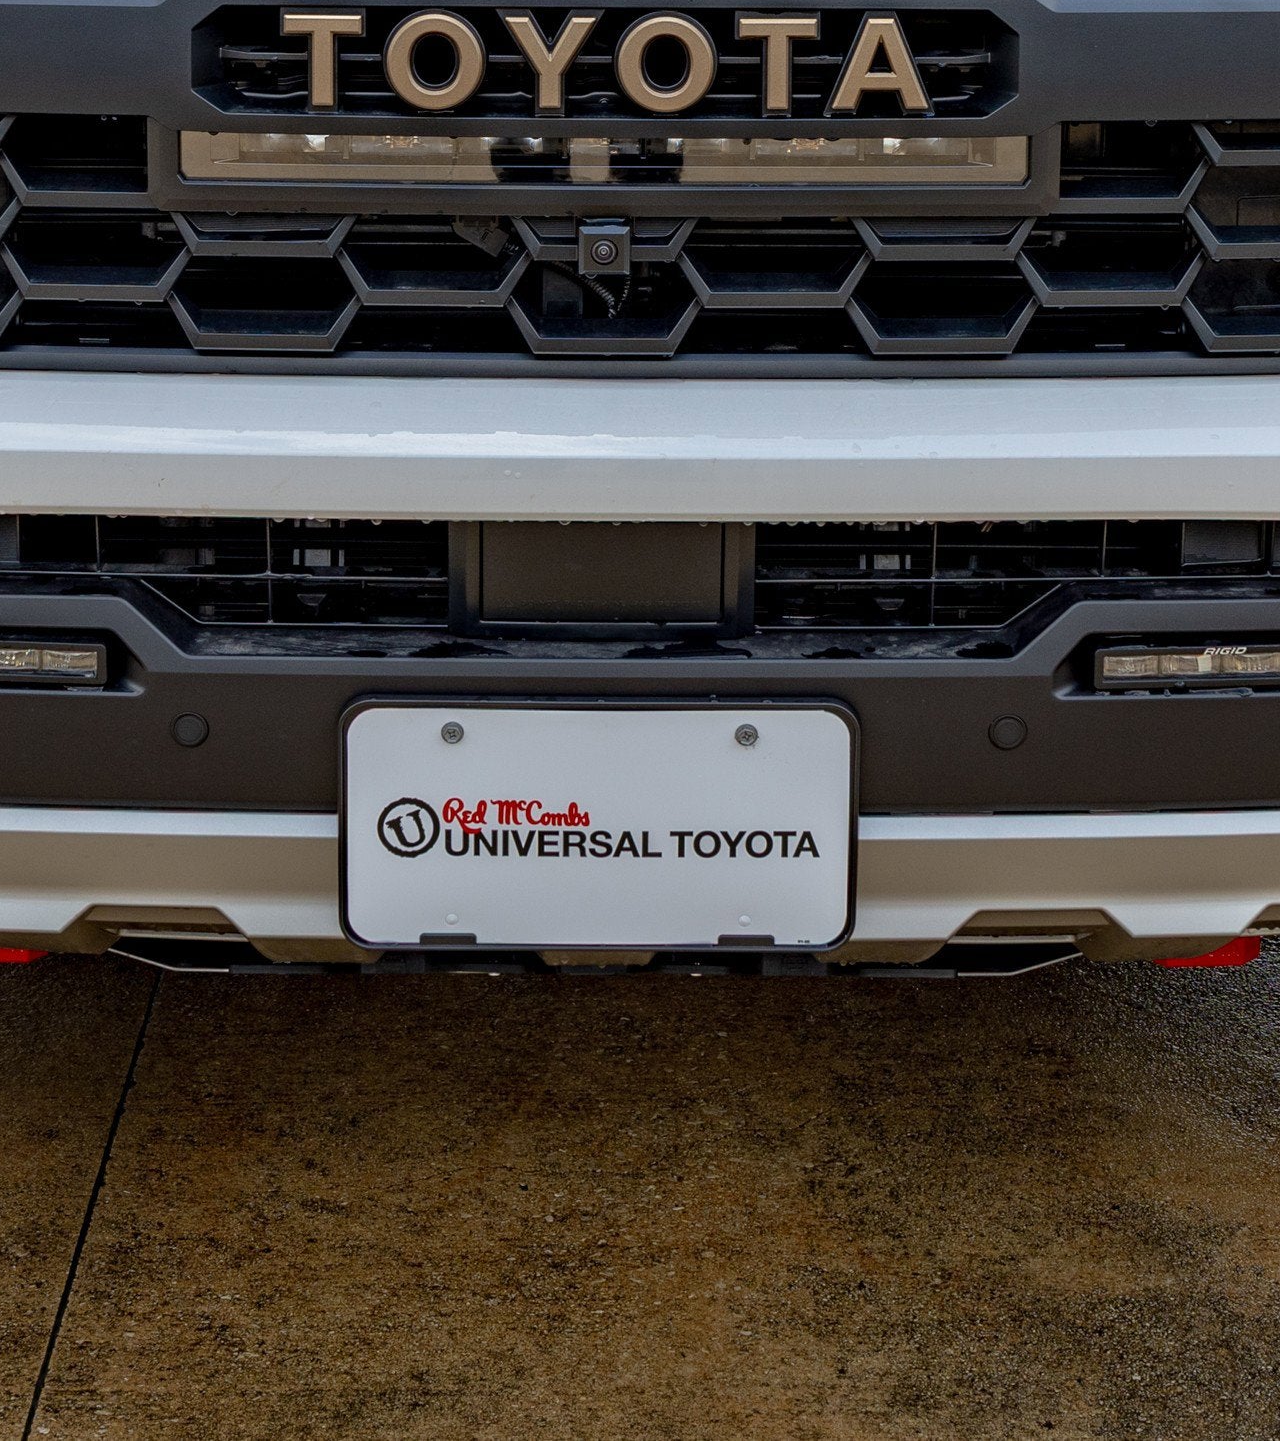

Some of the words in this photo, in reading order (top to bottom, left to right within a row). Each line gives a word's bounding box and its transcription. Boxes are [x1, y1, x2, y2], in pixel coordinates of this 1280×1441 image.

[281, 9, 933, 115] TOYOTA
[1204, 646, 1248, 656] RIGID
[442, 797, 488, 834] Red
[445, 829, 662, 858] UNIVERSAL
[670, 830, 820, 858] TOYOTA
